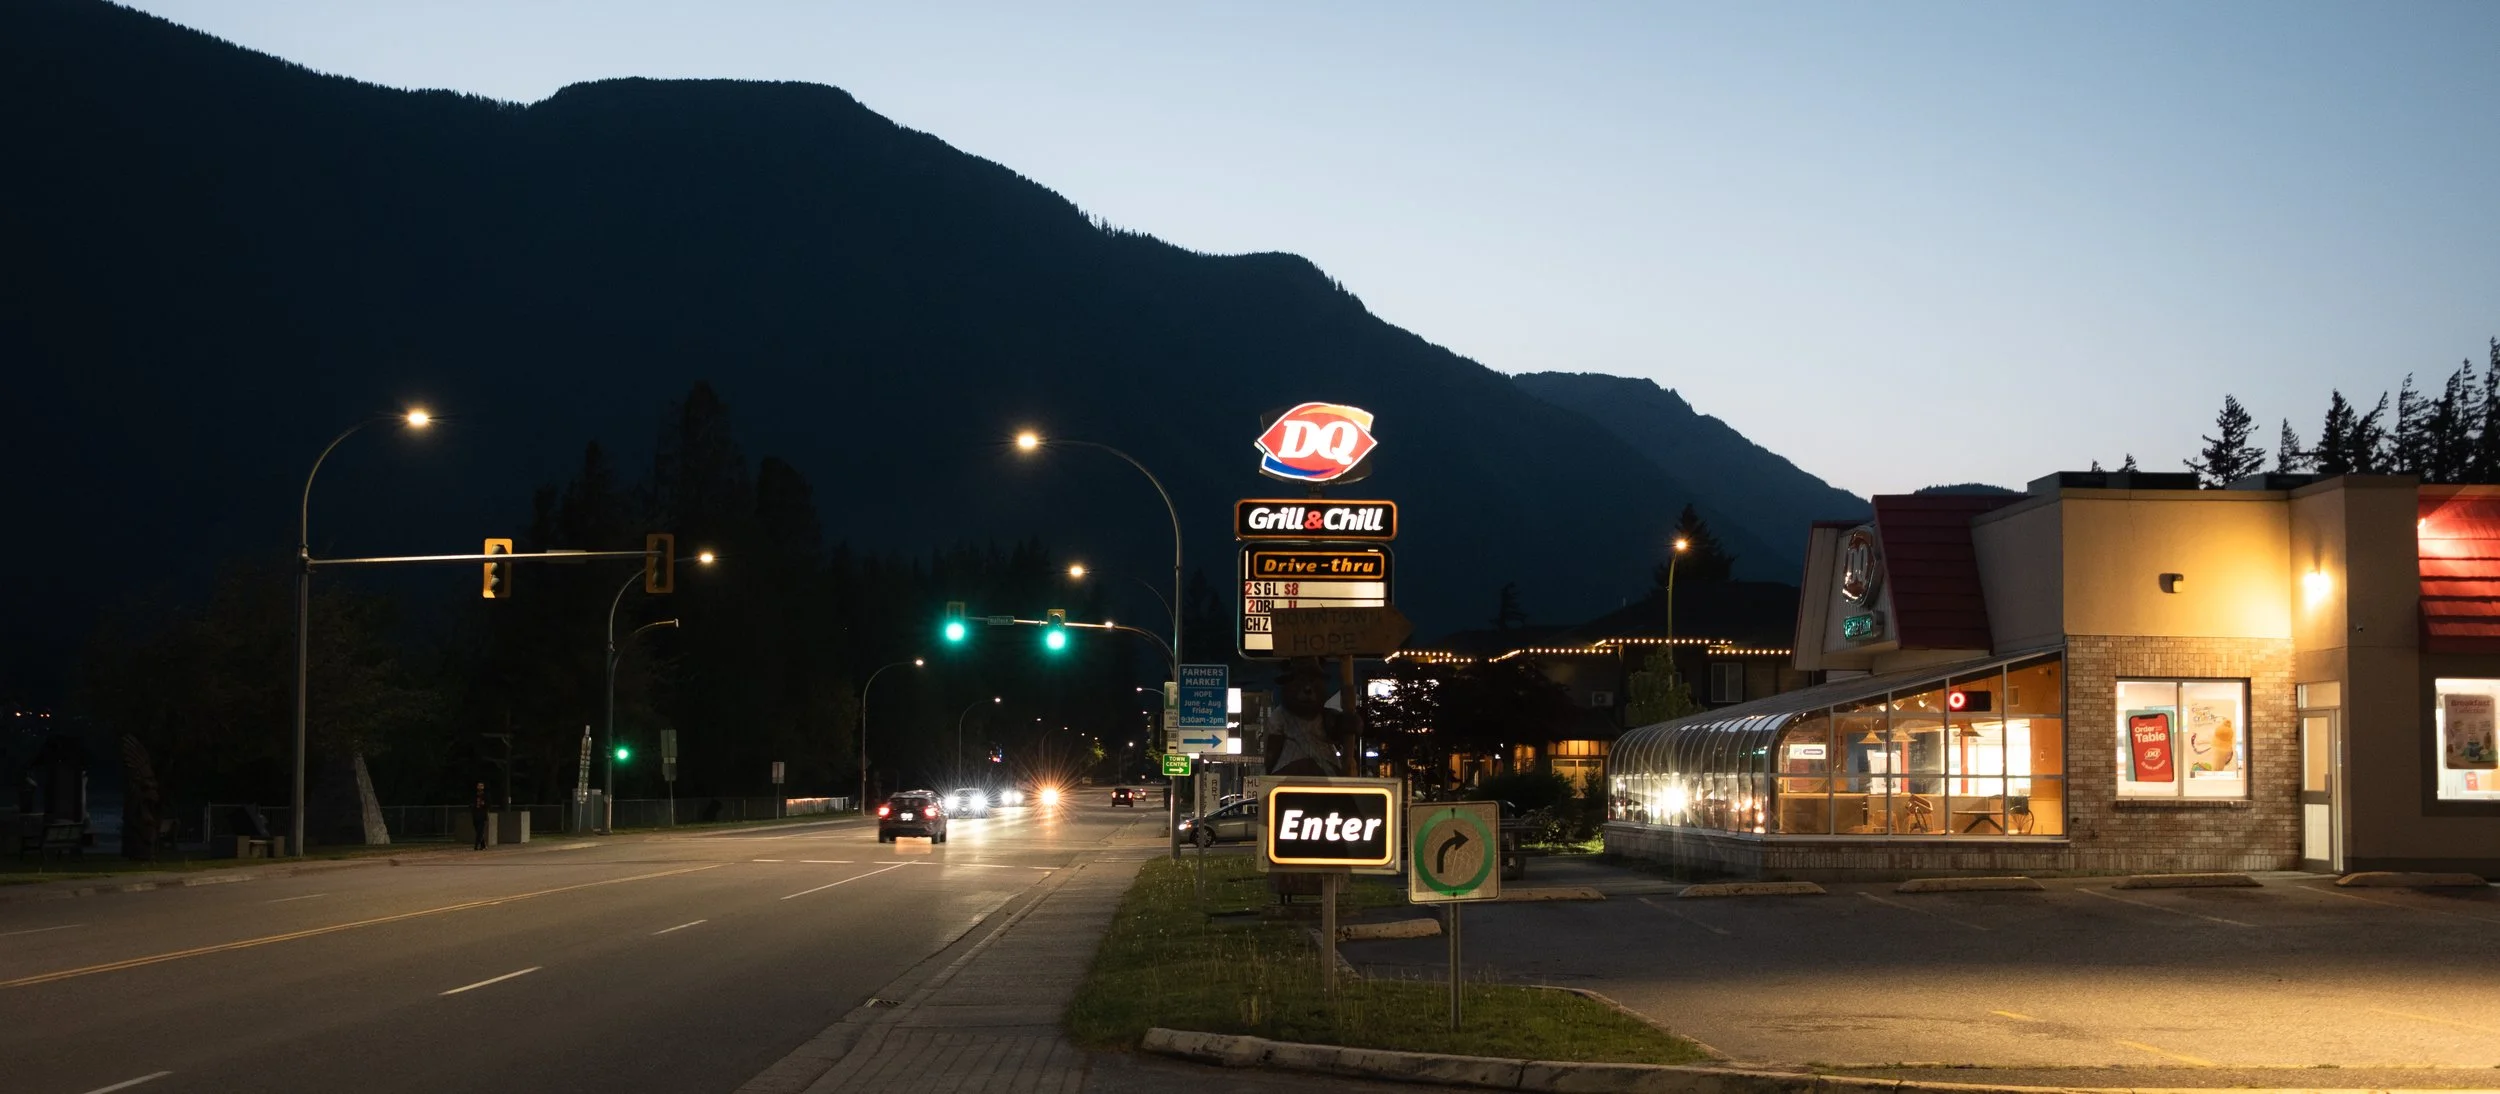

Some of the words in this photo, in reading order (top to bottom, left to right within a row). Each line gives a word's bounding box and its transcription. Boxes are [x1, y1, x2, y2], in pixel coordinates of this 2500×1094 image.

[1278, 420, 1358, 465] DQ
[1294, 632, 1357, 651] HOPE
[1182, 668, 1223, 676] FARMERS
[1185, 678, 1220, 686] MARKET
[2135, 732, 2166, 743] Table
[1279, 809, 1382, 842] Enter
